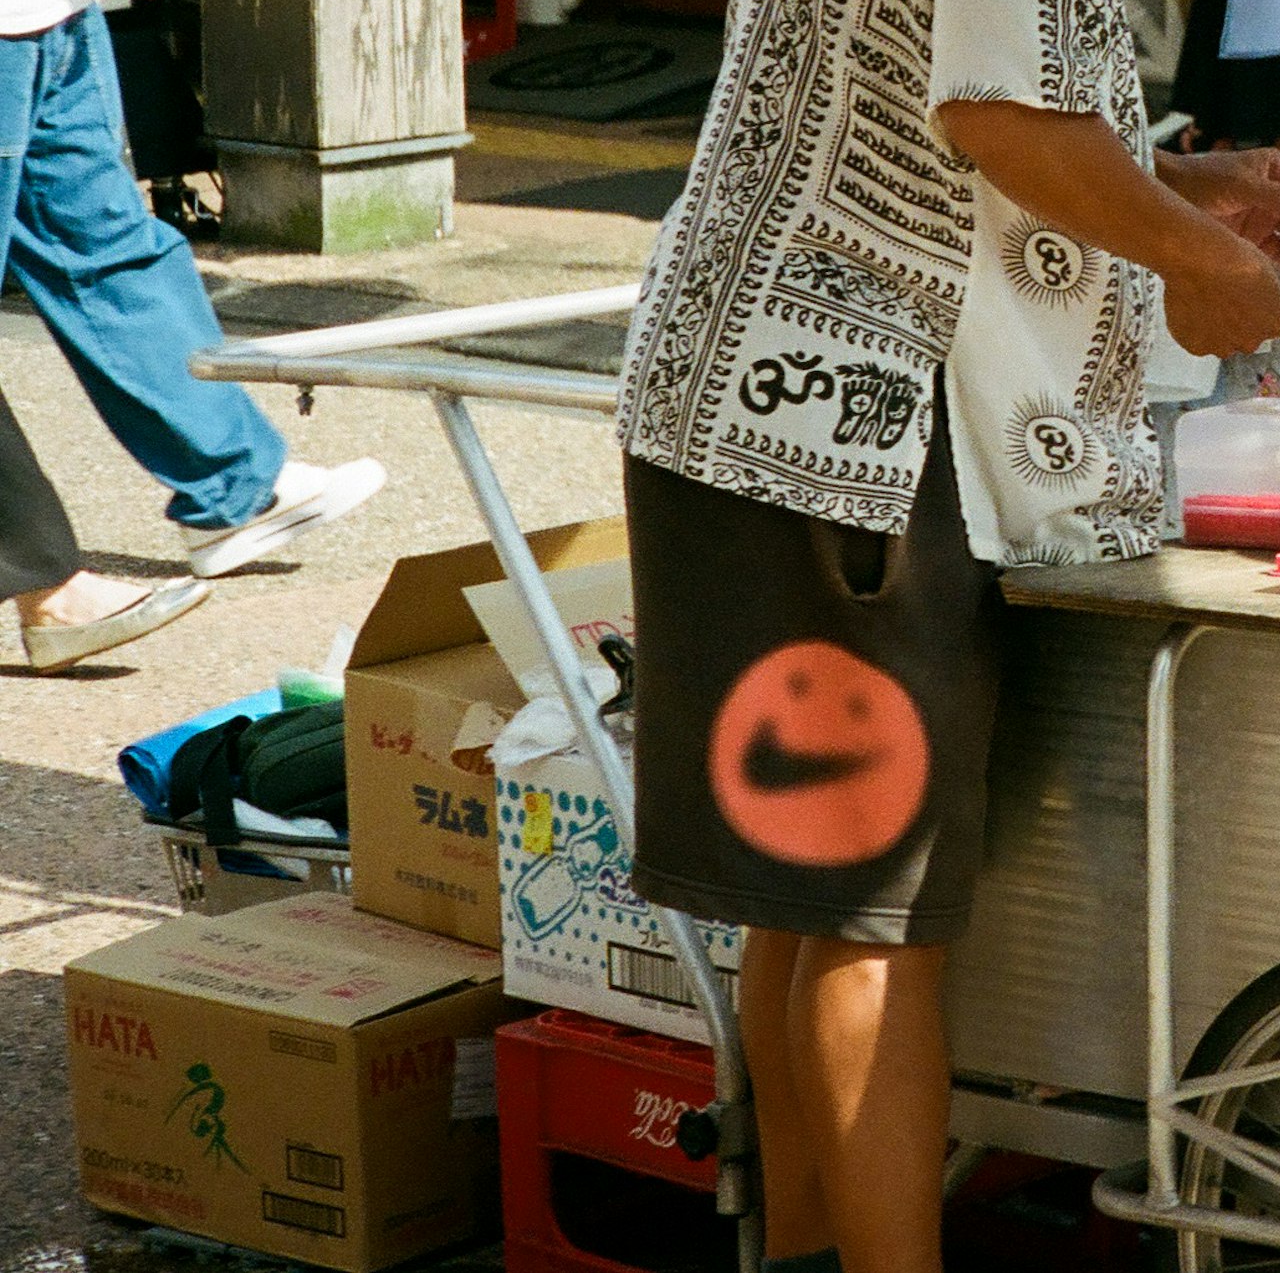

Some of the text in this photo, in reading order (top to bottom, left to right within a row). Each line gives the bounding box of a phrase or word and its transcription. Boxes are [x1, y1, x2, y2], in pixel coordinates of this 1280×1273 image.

[413, 784, 489, 839] ラムネ
[75, 1007, 158, 1061] HATA
